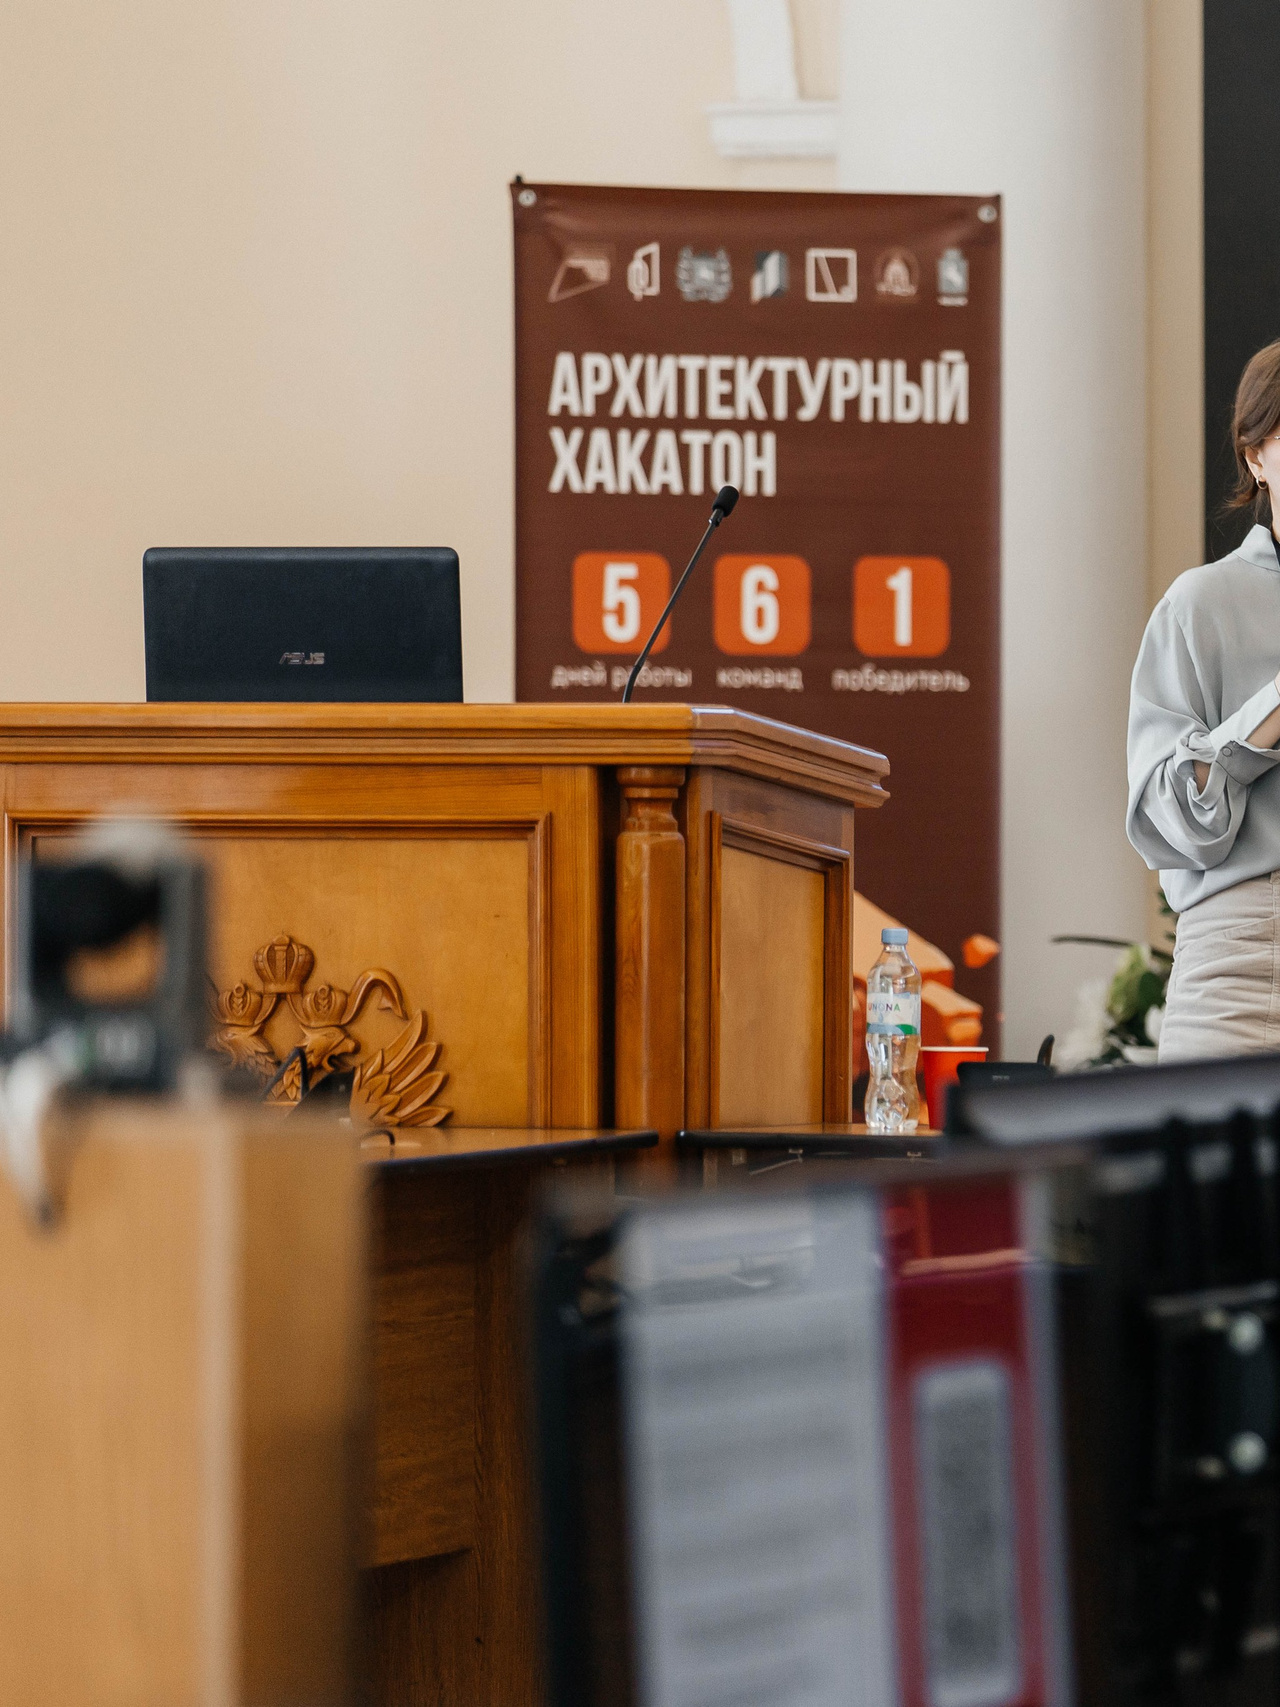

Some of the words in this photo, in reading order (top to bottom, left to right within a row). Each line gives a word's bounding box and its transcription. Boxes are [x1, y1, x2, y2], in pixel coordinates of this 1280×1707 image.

[548, 351, 970, 424] АРХИТЕКТУРНЫЙ
[549, 427, 777, 497] ХАКАТОН
[602, 562, 641, 643] 5
[740, 564, 780, 645] 6
[886, 566, 913, 647] 1
[279, 652, 325, 665] ASUS
[552, 660, 607, 689] дней
[716, 667, 804, 692] команд
[831, 662, 970, 694] победитель
